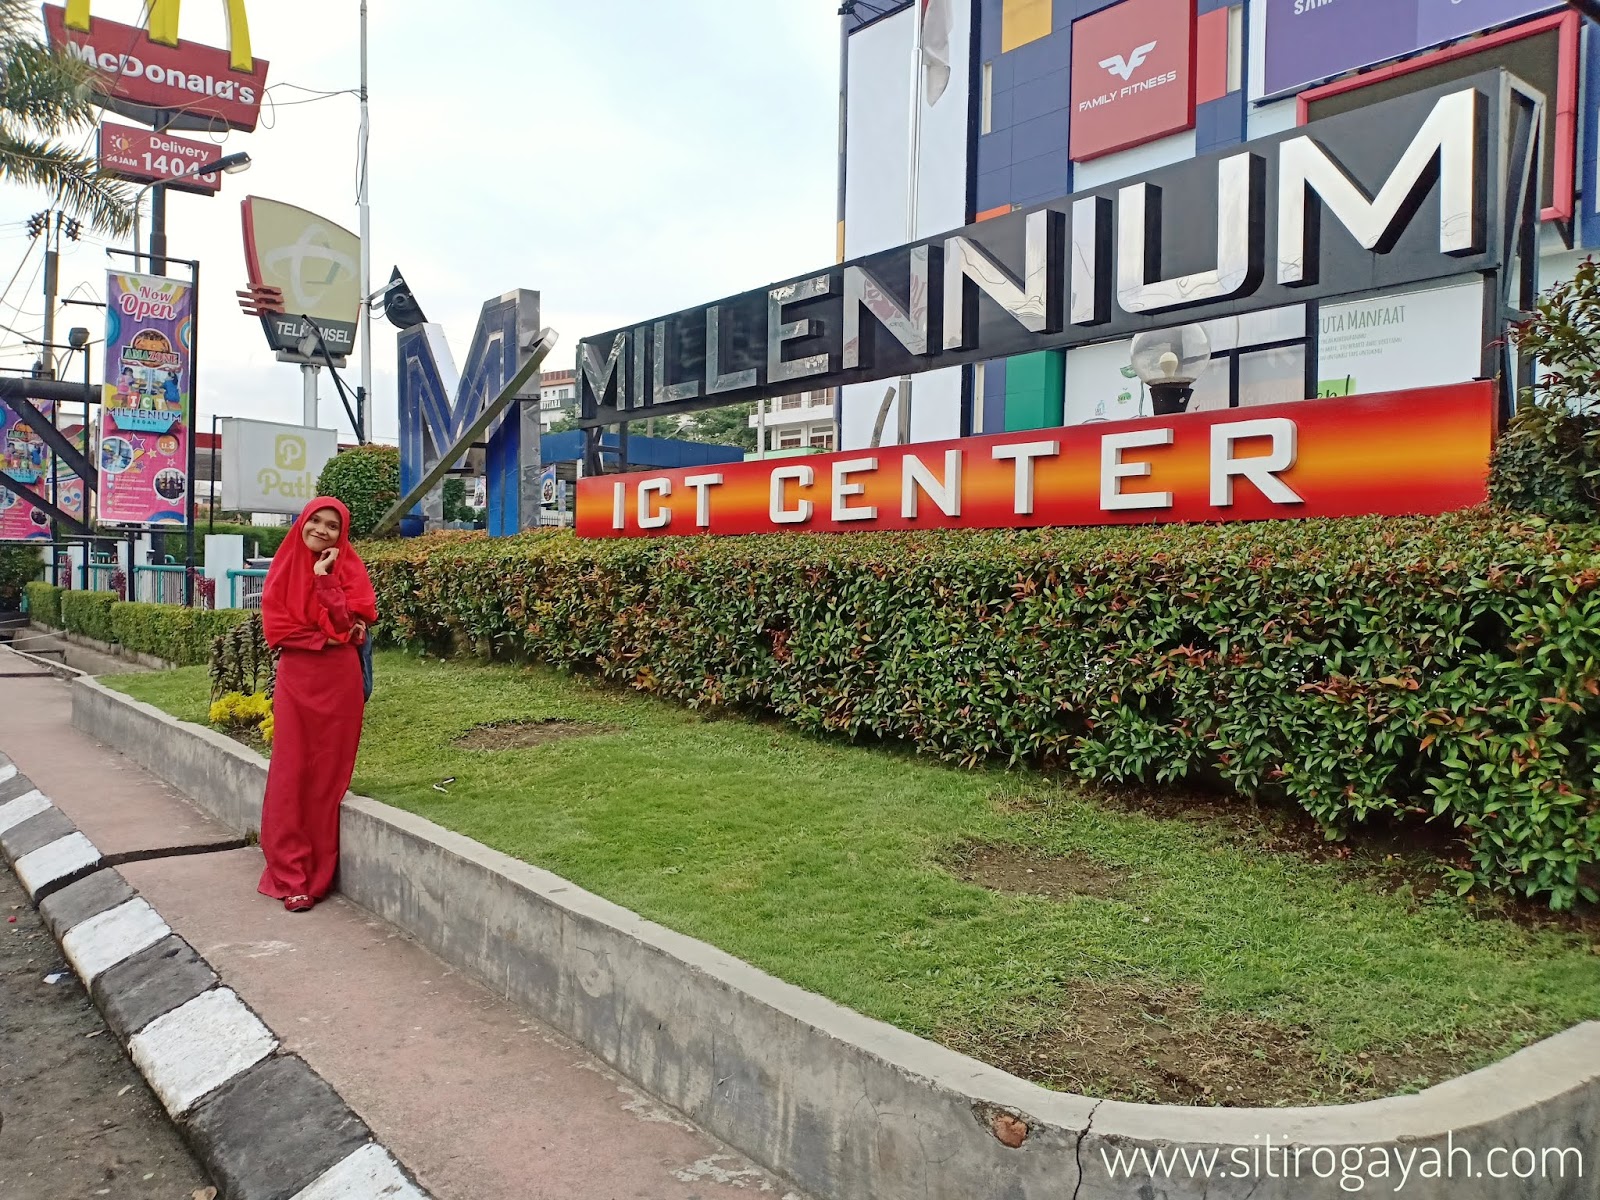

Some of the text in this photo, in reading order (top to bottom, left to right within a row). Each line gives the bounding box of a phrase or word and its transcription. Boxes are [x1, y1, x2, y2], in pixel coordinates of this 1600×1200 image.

[65, 40, 255, 105] McDonald's
[1079, 70, 1176, 112] FAMILY FITNESS
[106, 154, 138, 167] 24 JAM
[149, 137, 209, 161] Delivery
[576, 88, 1488, 420] MILLENNIUM
[139, 286, 171, 302] Now
[119, 292, 176, 321] Open
[276, 320, 351, 344] TELKMSEL
[1319, 314, 1344, 334] UTA
[128, 395, 165, 410] ICT
[611, 417, 1304, 530] ICT CENTER
